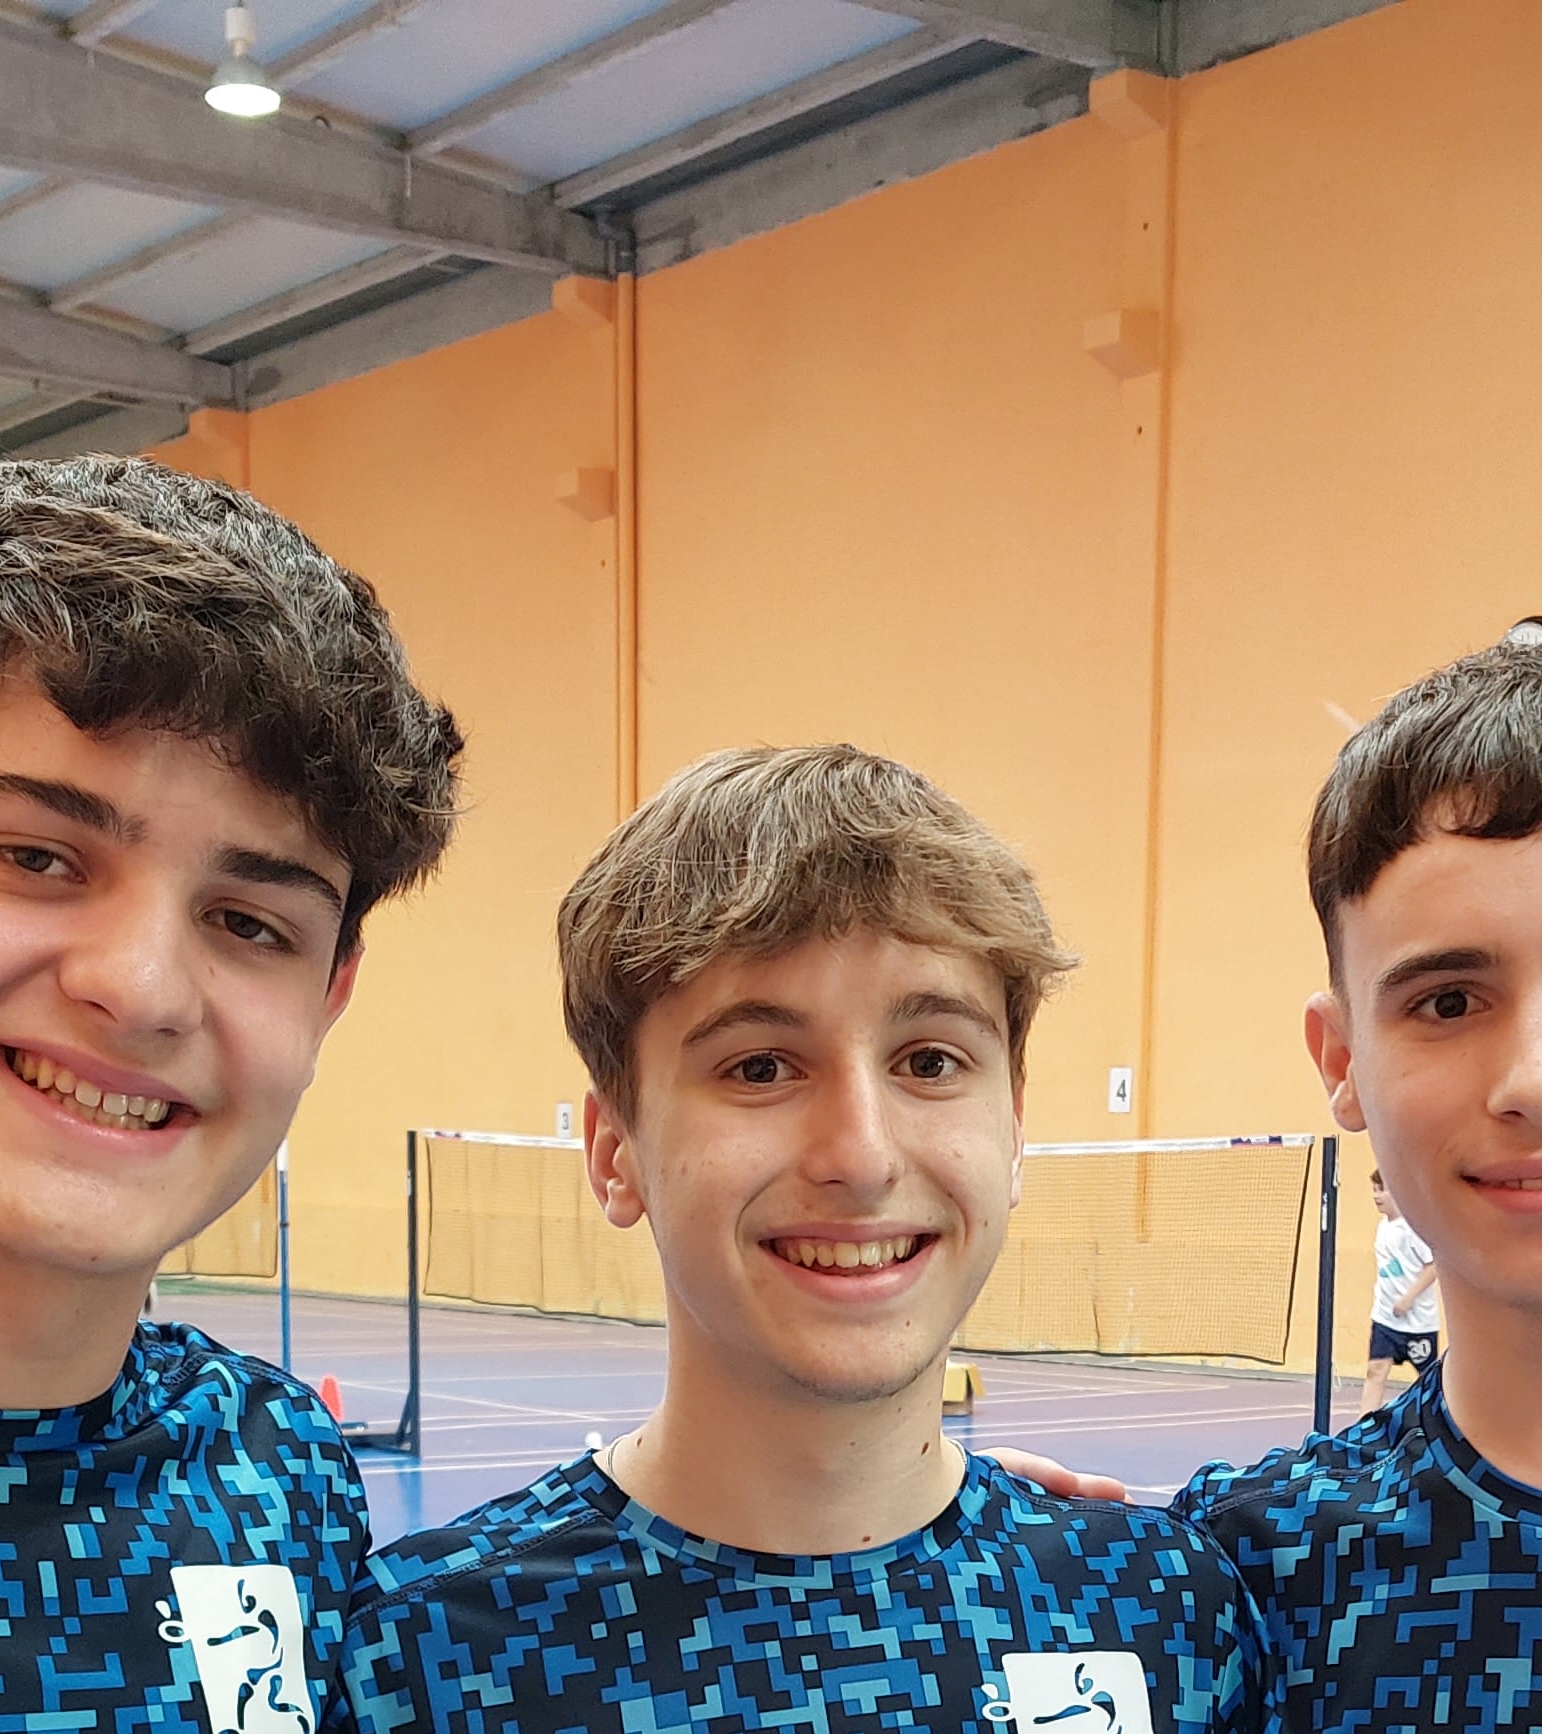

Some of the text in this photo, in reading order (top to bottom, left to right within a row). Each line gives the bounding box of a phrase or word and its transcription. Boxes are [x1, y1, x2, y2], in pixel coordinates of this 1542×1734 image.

[1116, 1079, 1127, 1102] 4
[562, 1111, 569, 1130] 3
[1407, 1338, 1432, 1365] 30
